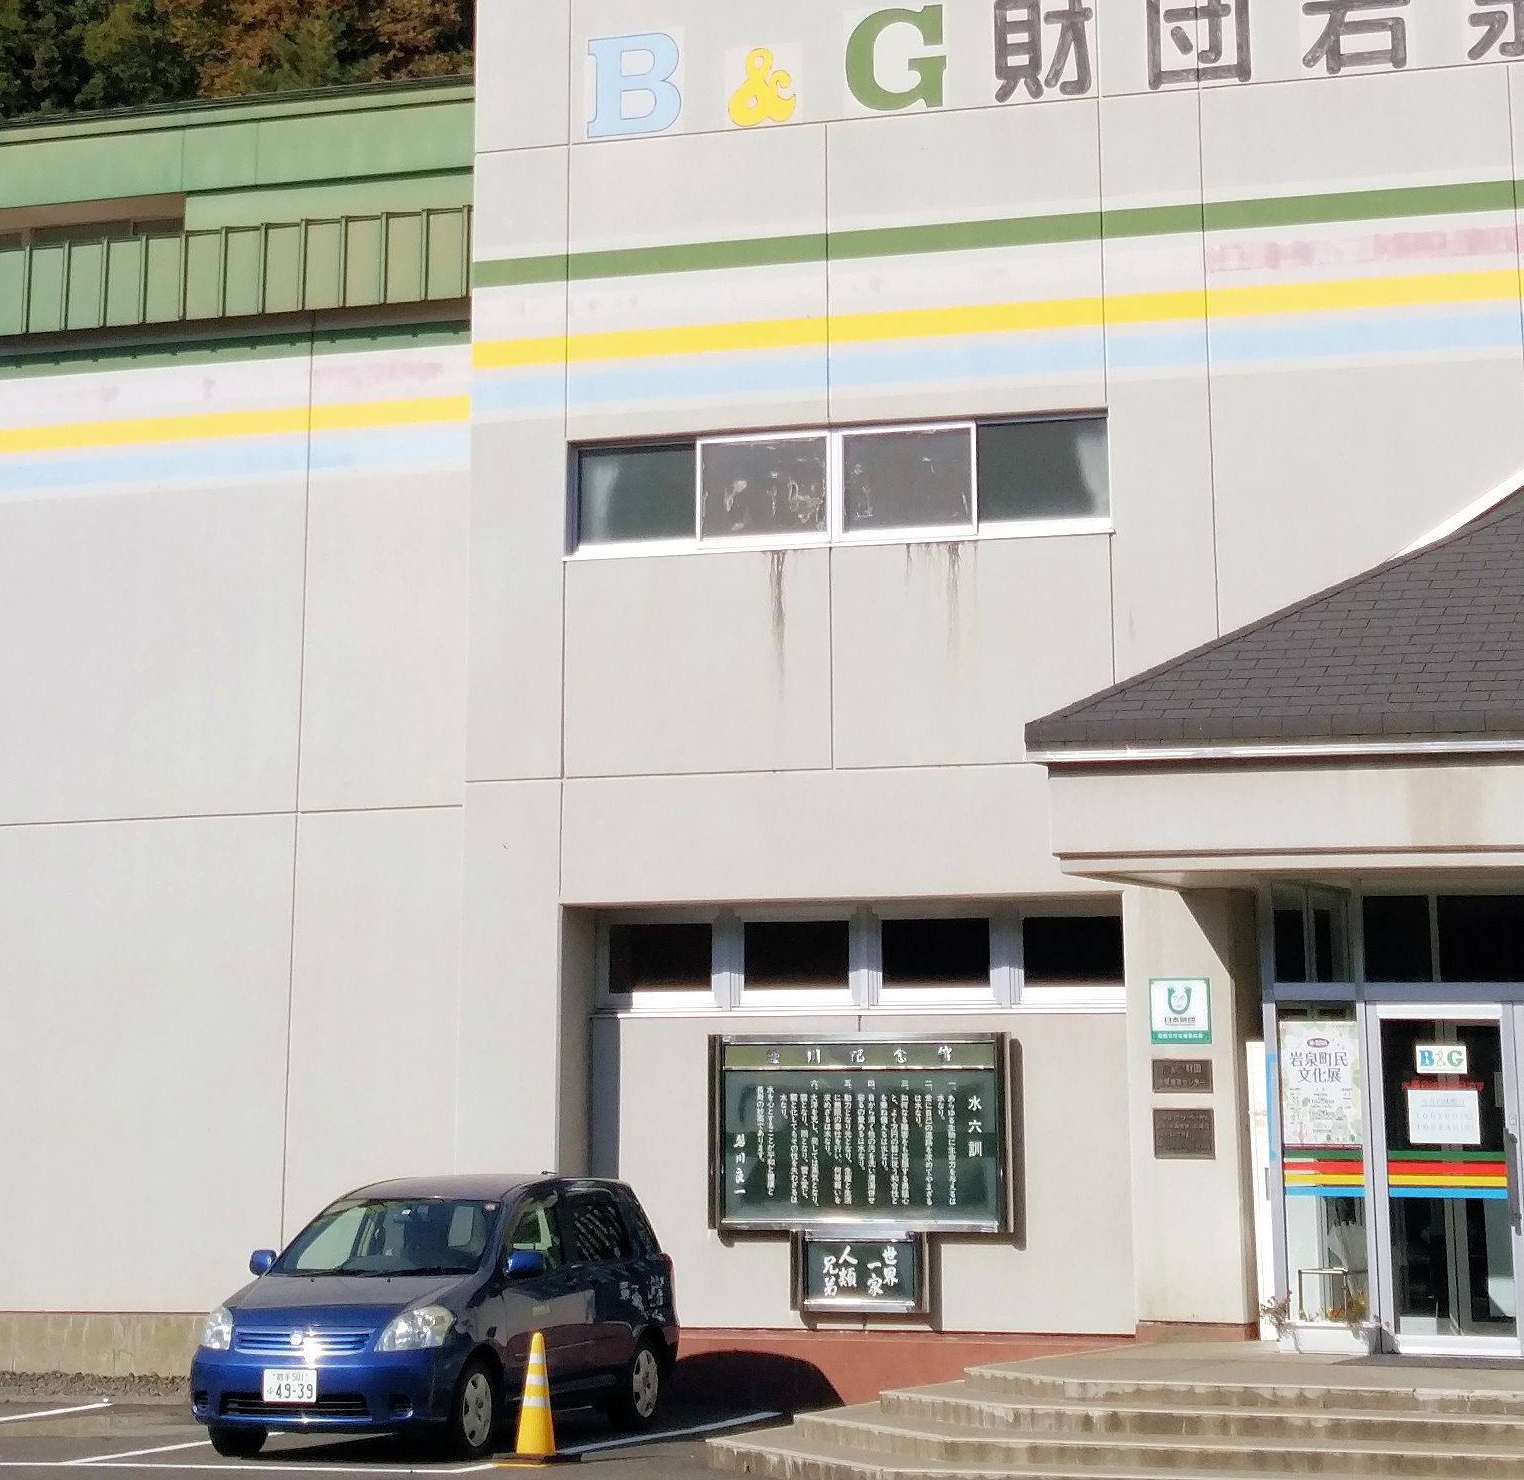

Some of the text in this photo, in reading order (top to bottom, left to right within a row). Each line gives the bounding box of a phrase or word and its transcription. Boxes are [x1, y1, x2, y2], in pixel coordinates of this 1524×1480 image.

[1289, 1051, 1349, 1067] 岩泉町民
[1298, 1067, 1341, 1083] 文化展
[967, 1095, 983, 1158] 水六訓
[276, 1383, 313, 1399] 49-39
